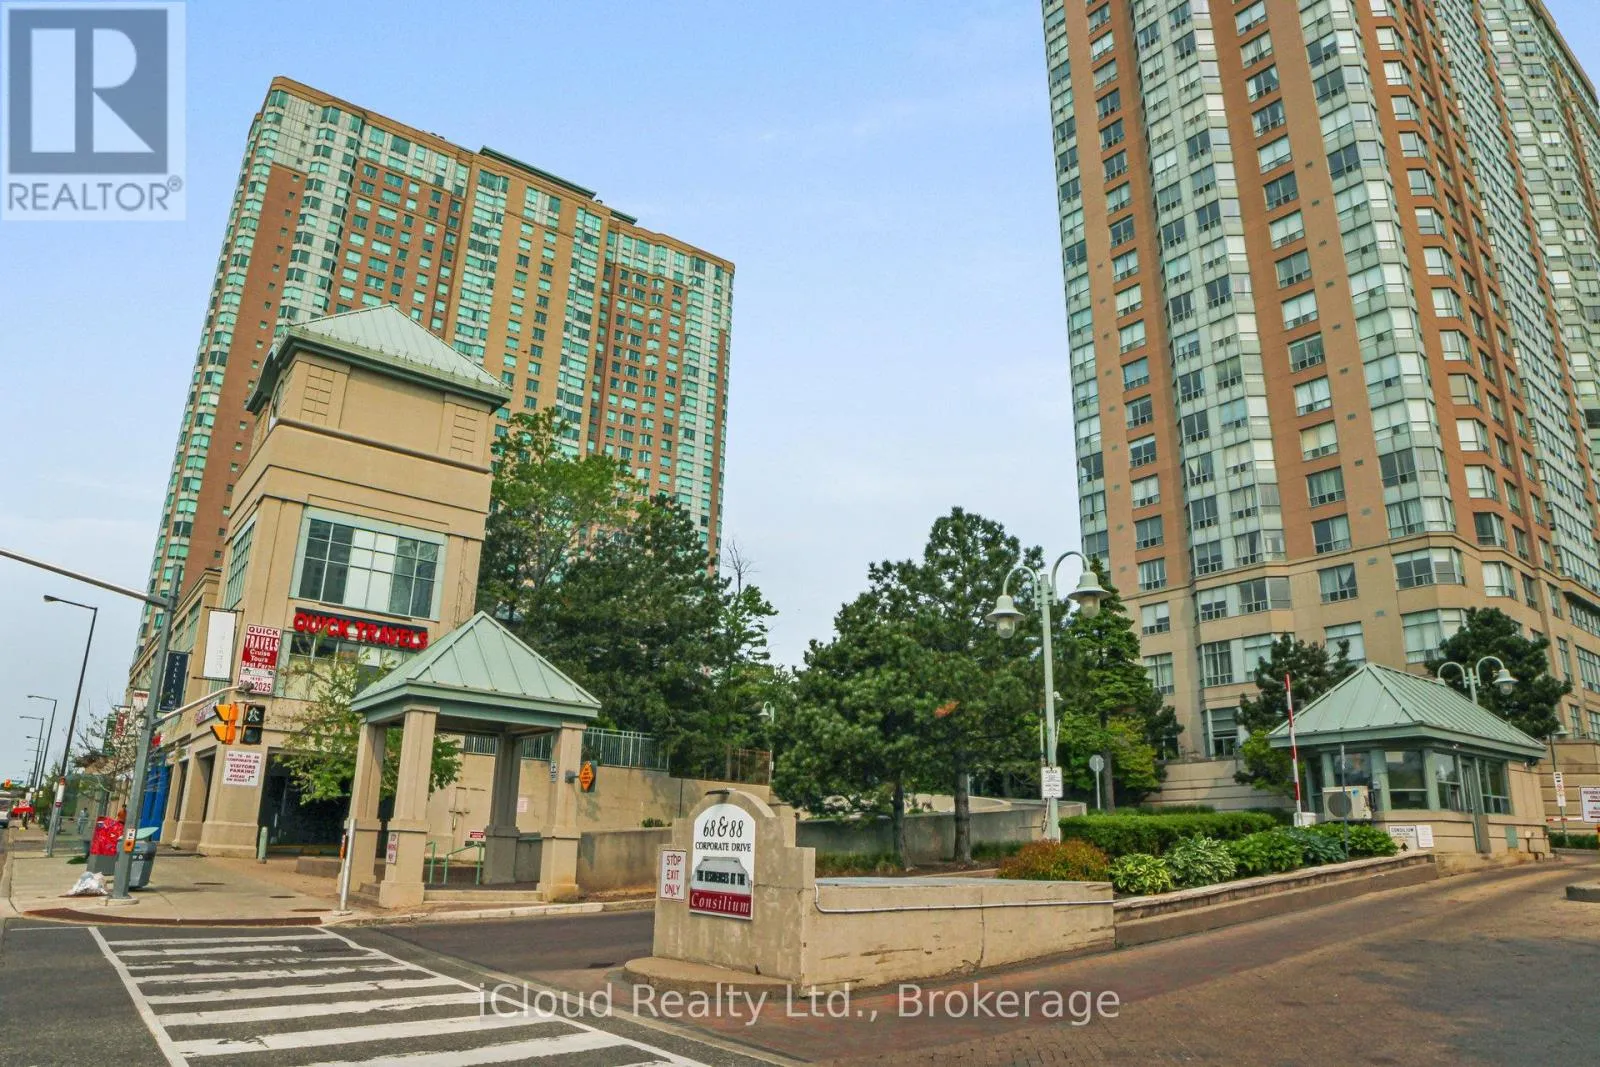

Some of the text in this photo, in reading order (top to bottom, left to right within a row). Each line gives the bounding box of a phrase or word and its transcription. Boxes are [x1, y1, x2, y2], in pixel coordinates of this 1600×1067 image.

[248, 626, 279, 636] QUICK
[293, 612, 428, 650] QUICK TRAVELS
[245, 634, 279, 651] TRAVELS
[250, 649, 271, 657] Cruise
[695, 841, 752, 852] CORPORATE DRIVE
[666, 854, 682, 866] STOP
[666, 869, 680, 880] EXIT
[664, 883, 681, 897] ONLY
[691, 892, 750, 914] Consilium
